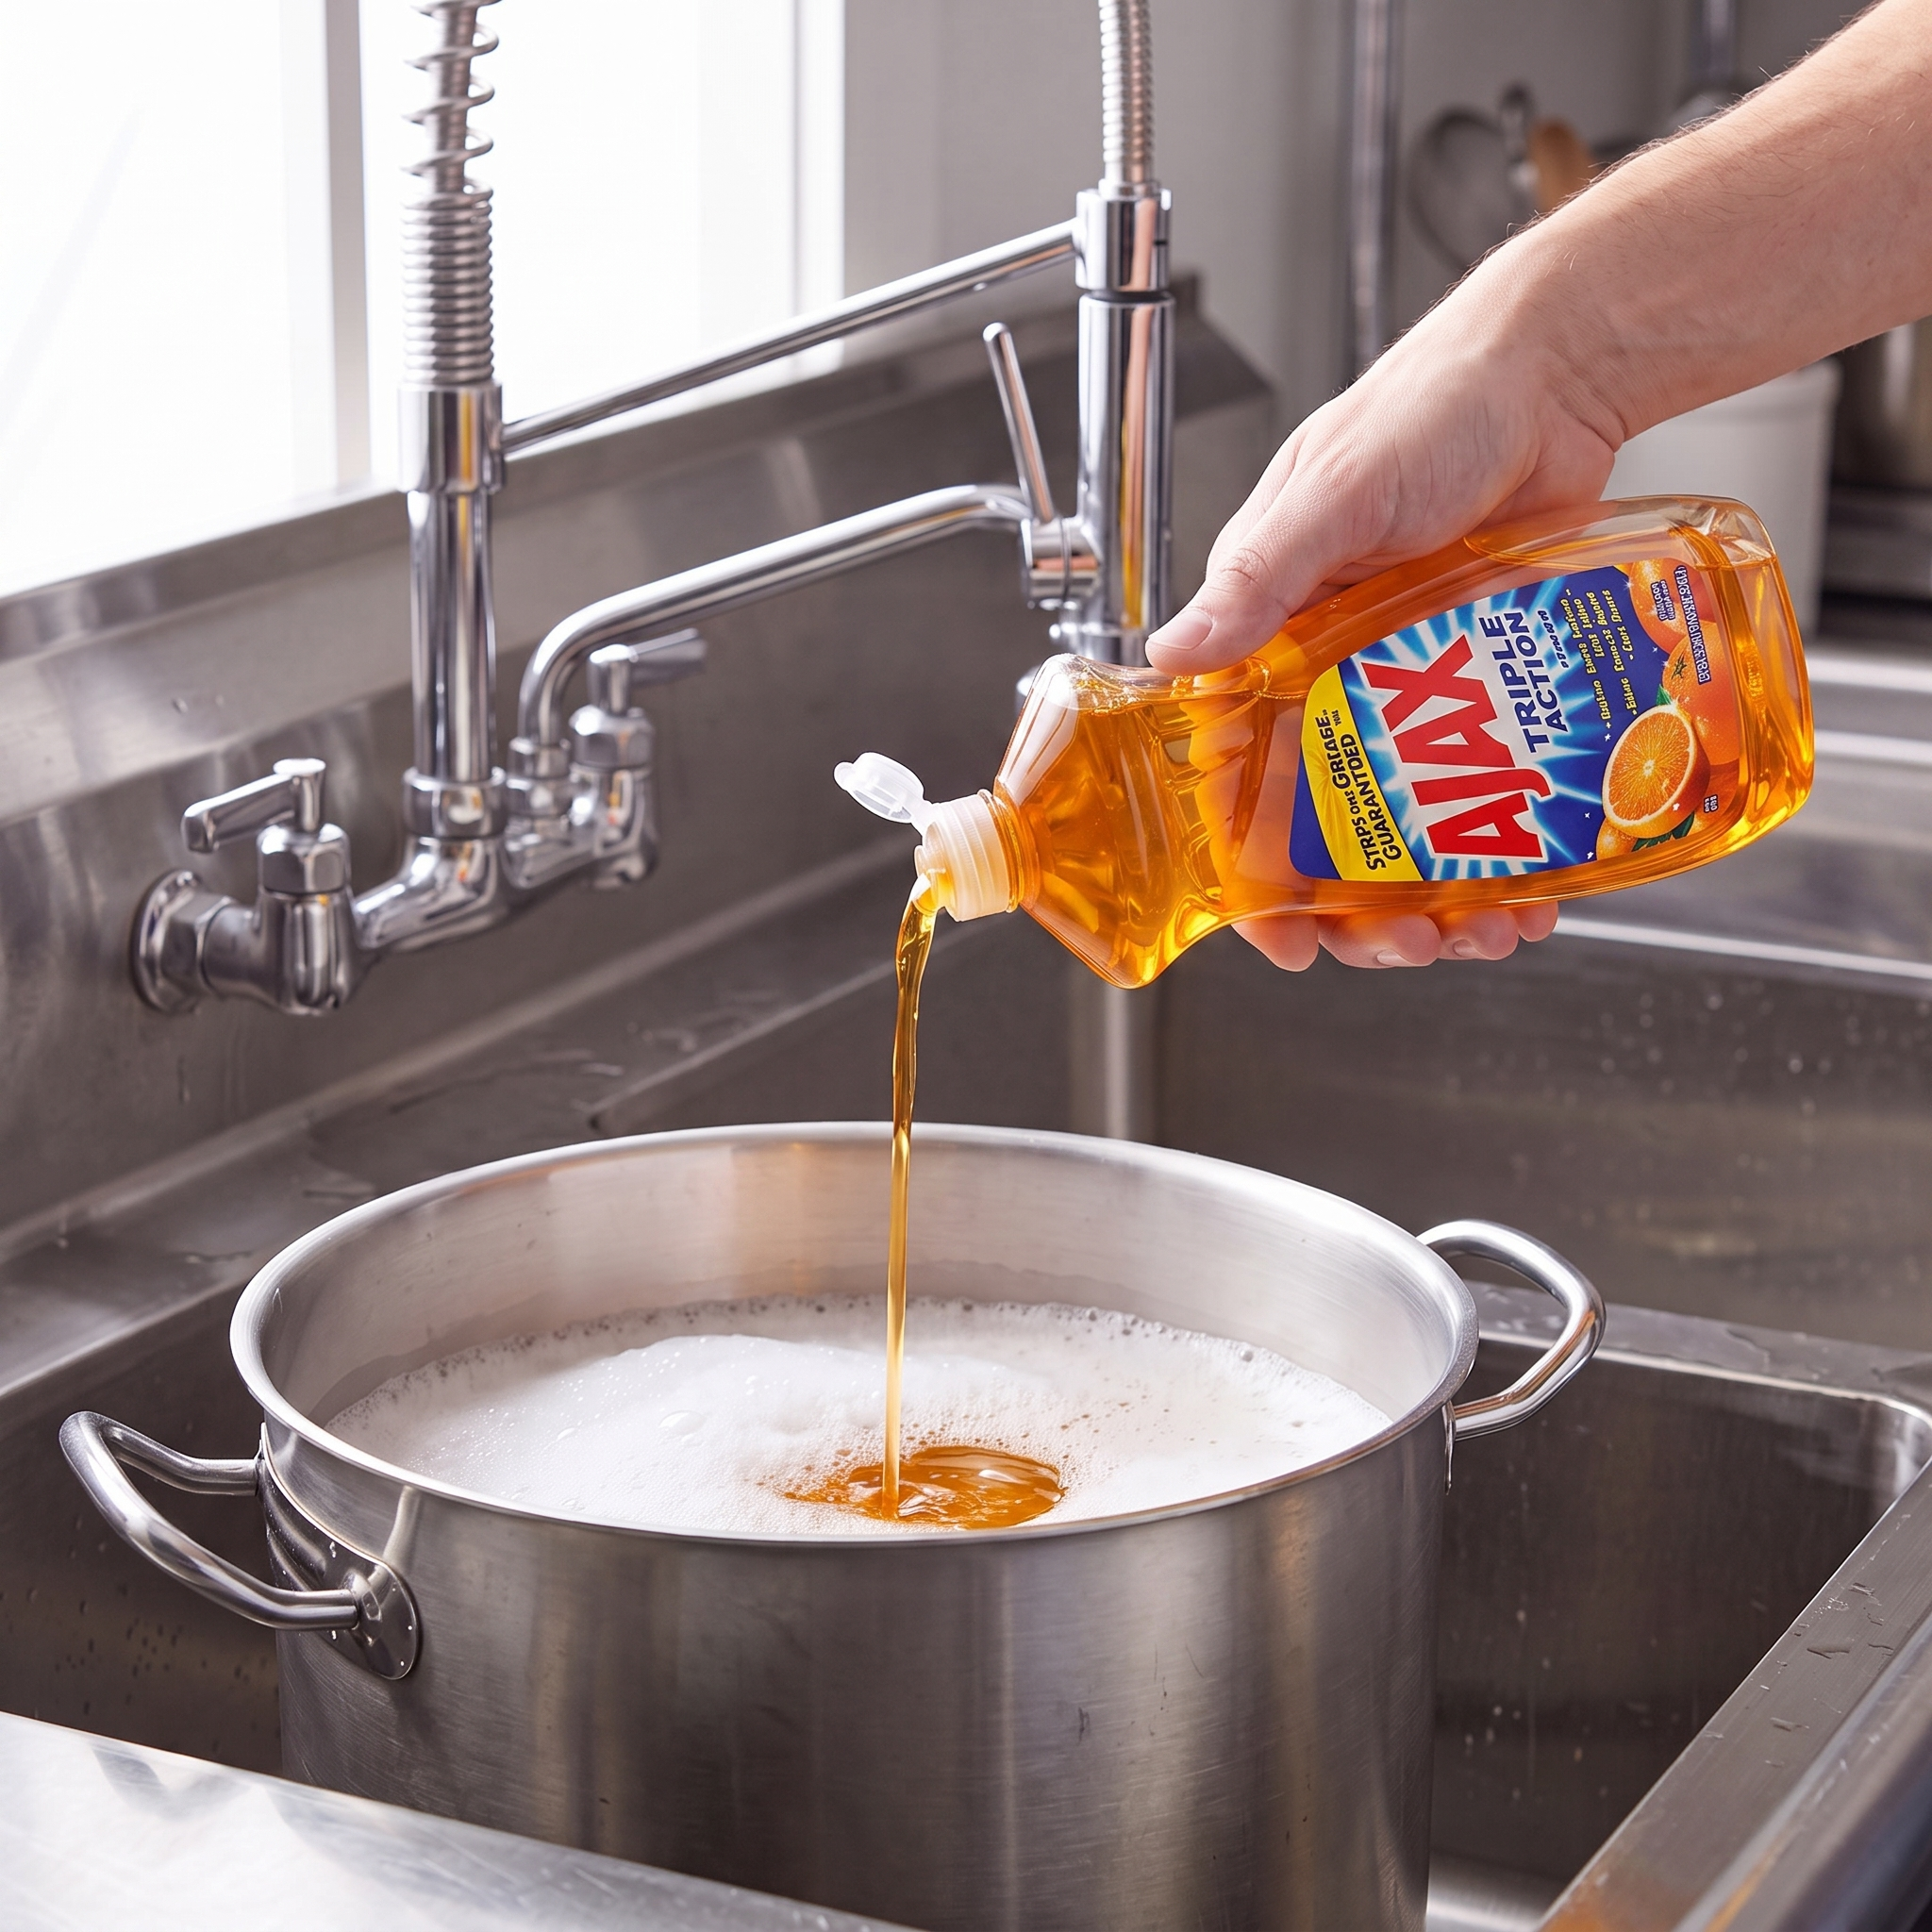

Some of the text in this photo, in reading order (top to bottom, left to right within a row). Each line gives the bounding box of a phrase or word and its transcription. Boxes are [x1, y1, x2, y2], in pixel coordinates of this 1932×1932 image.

[1479, 615, 1550, 753] TRIPLE
[1504, 612, 1568, 732] ACTION
[1361, 634, 1552, 858] AJAX
[1351, 817, 1387, 870] STRPS
